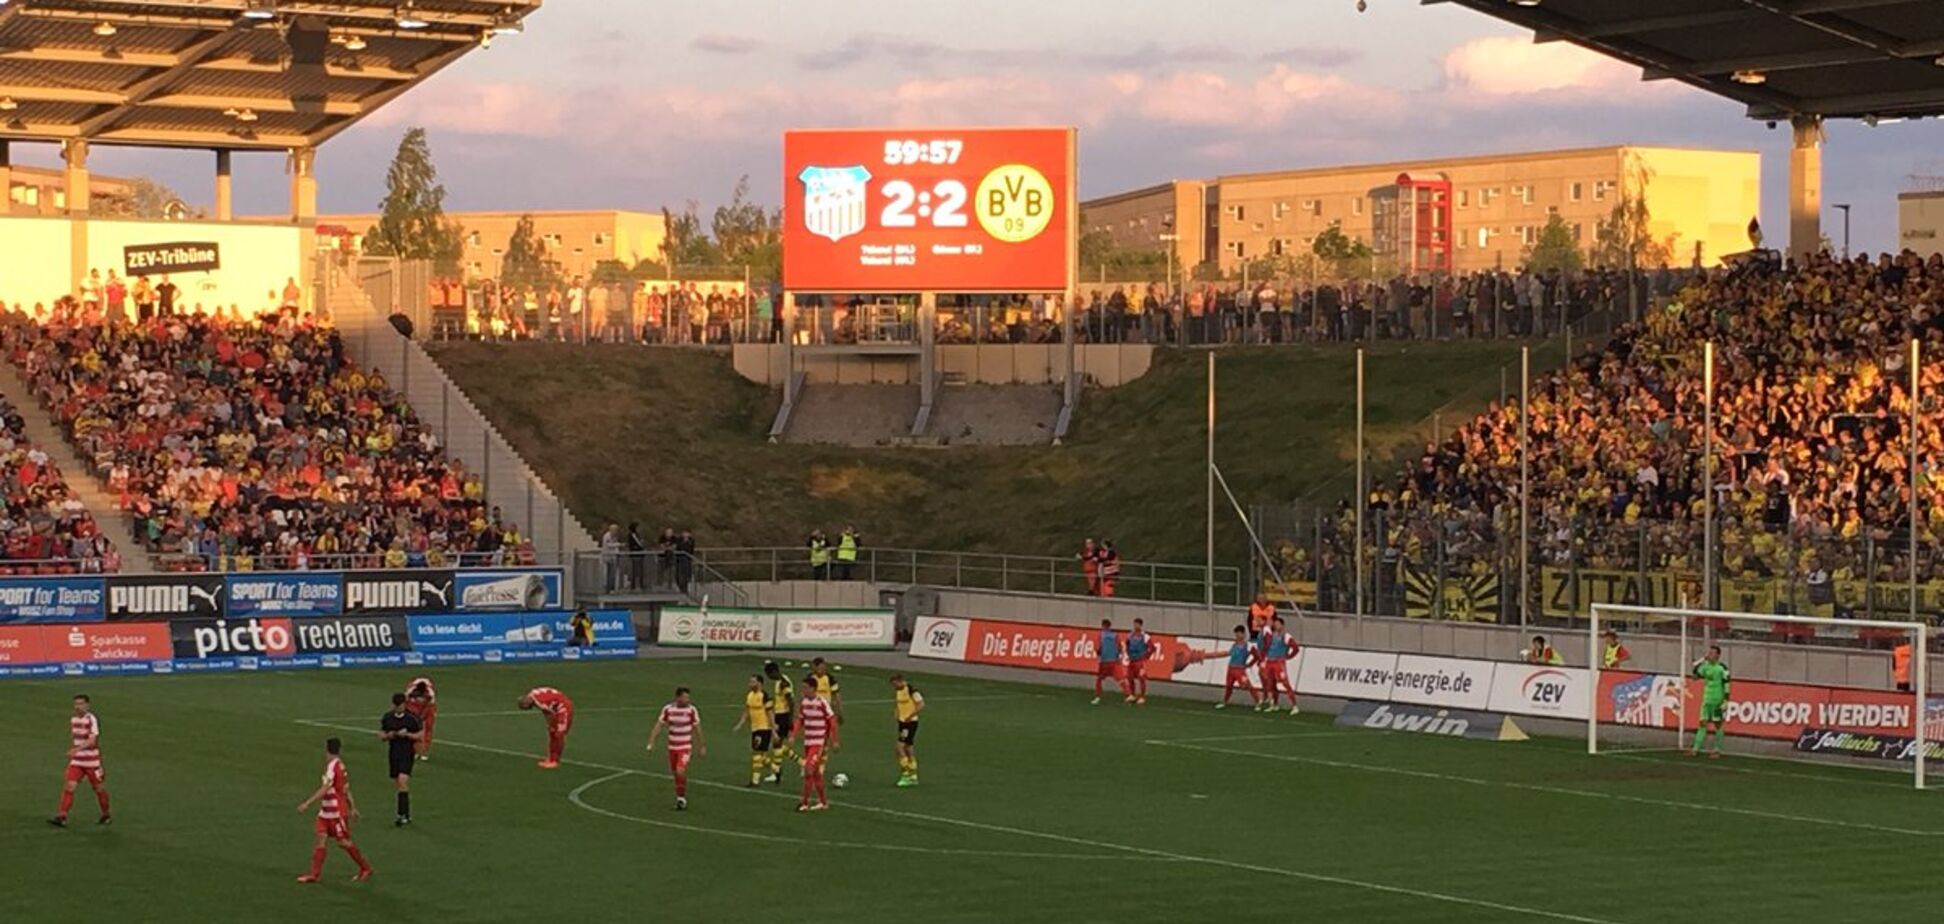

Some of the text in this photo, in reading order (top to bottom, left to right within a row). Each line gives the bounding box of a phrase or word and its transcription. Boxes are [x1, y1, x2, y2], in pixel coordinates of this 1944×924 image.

[884, 140, 963, 165] 59:57
[880, 180, 969, 228] 2:2
[127, 247, 217, 269] ZEV-Tribüne
[34, 587, 55, 605] for
[57, 587, 101, 605] Teams
[110, 585, 189, 614] PUMA
[232, 582, 338, 600] SPORT for Teams
[347, 581, 420, 608] PUMA
[90, 634, 147, 648] Sparkasse
[194, 618, 393, 658] picto reclame
[931, 630, 955, 648] zev
[983, 632, 1008, 656] Die
[1011, 633, 1071, 664] Energie
[93, 648, 139, 659] Zwickau
[1324, 664, 1472, 695] www.zev-energie.de
[1532, 682, 1566, 703] zev
[1364, 705, 1470, 736] bwin
[1722, 699, 1910, 728] PONSOR WERDEN
